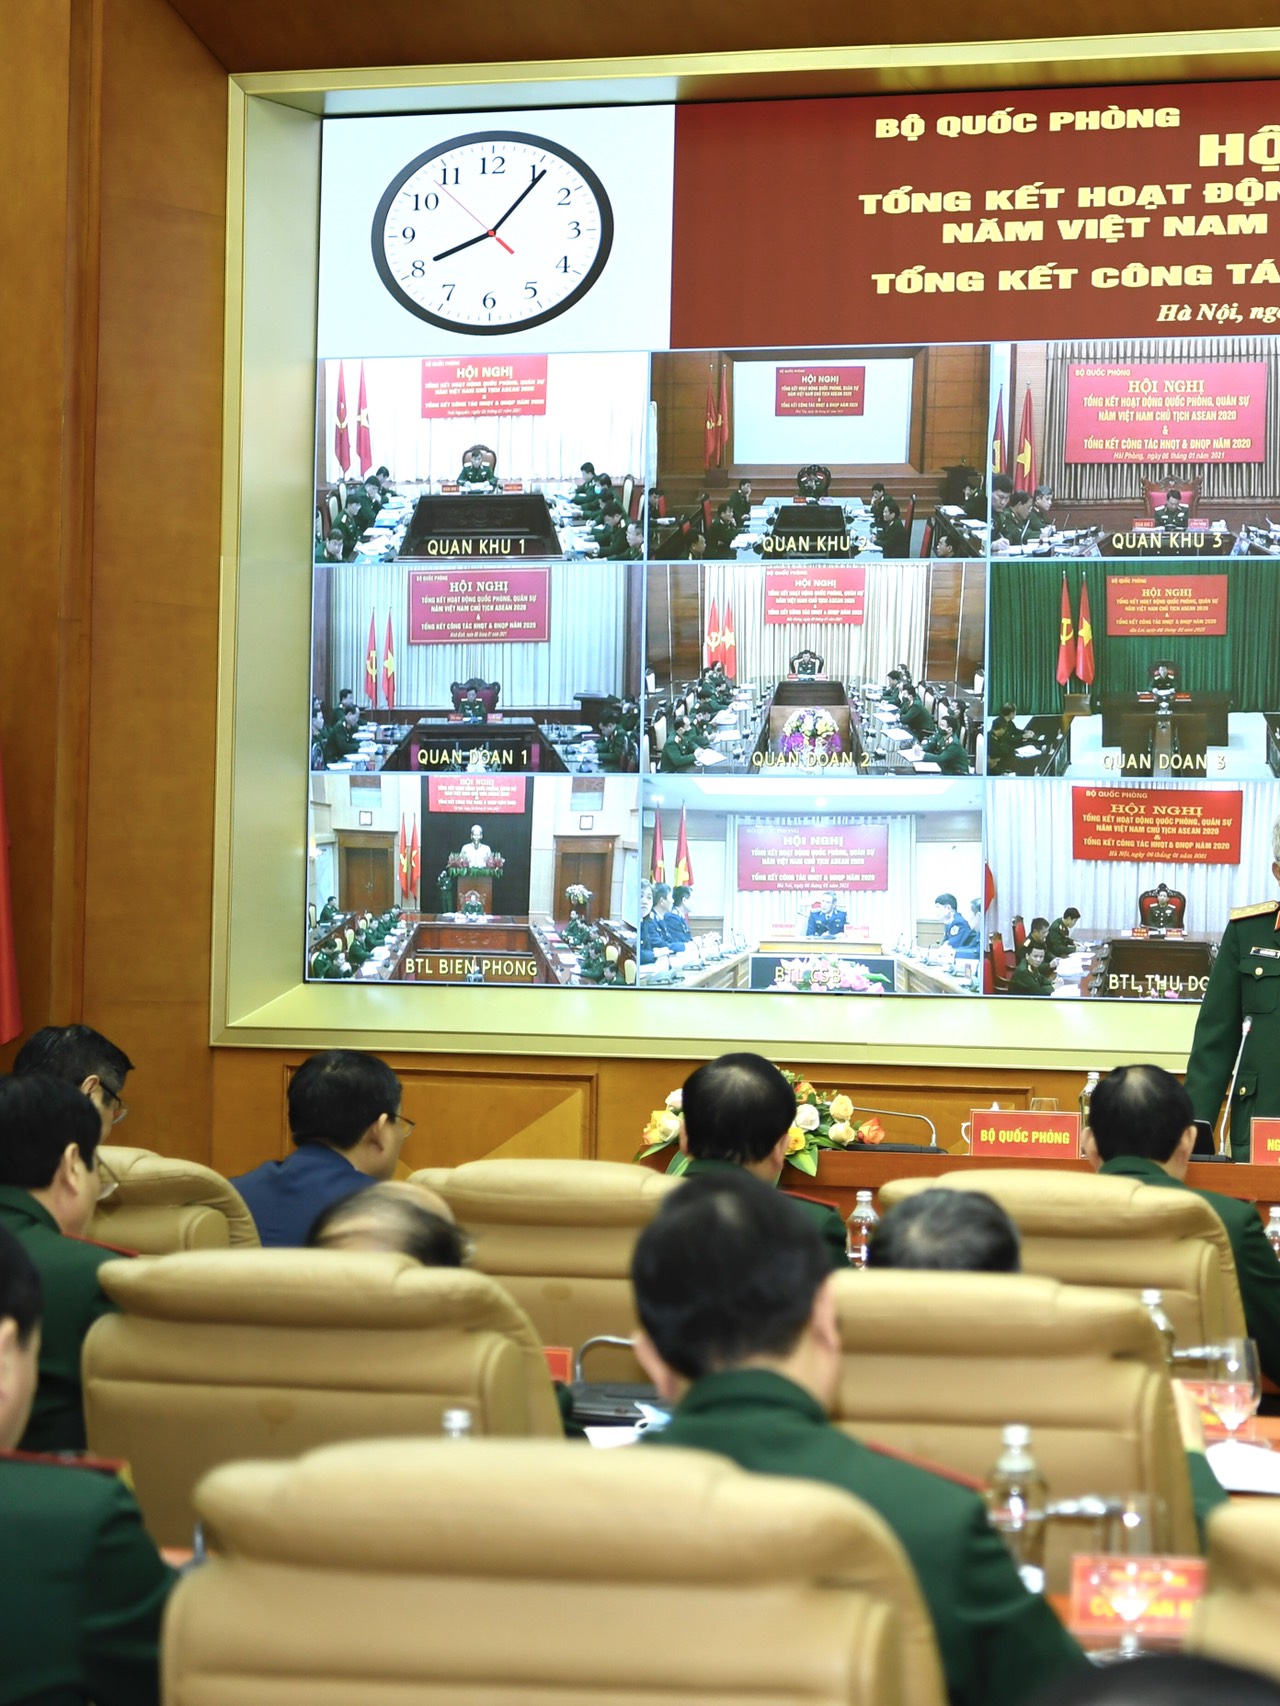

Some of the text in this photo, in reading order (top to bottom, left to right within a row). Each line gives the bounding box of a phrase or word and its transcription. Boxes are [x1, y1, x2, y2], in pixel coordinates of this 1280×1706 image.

[876, 105, 1180, 141] BỘ QUỐC PHÒNG
[480, 156, 506, 175] 12
[440, 168, 462, 186] 11
[413, 193, 440, 211] 10
[556, 187, 572, 206] 2
[859, 186, 971, 214] TỔNG
[986, 182, 1065, 210] KẾT
[1078, 184, 1192, 210] HOẠT
[401, 227, 417, 243] 9
[567, 221, 582, 239] 3
[943, 218, 1043, 243] NĂM
[1057, 214, 1150, 243] VIỆT
[1164, 214, 1268, 237] NAM
[410, 261, 426, 277] 8
[556, 256, 571, 273] 4
[871, 265, 984, 294] TỔNG
[999, 262, 1078, 291] KẾT
[1091, 263, 1212, 288] CÔNG
[441, 284, 457, 302] 7
[523, 281, 539, 298] 5
[481, 293, 498, 308] 6
[1156, 304, 1192, 321] Hà
[1196, 303, 1243, 324] Nội,
[457, 365, 513, 380] HỘI NGHỊ
[801, 374, 815, 386] HỘI
[1128, 378, 1204, 395] HỘI NGHỊ
[1136, 411, 1154, 421] NAM
[1191, 411, 1216, 420] ASEAN
[1218, 410, 1237, 420] 2020
[428, 539, 525, 556] QUAN KHU 1
[763, 536, 868, 552] QUAN KHU 2
[1112, 533, 1223, 549] QUAN KHU 3
[450, 580, 508, 594] HỘI NGHỊ
[1142, 587, 1192, 598] HỘI NGHỊ
[418, 749, 528, 765] QUAN DOAN 1
[752, 751, 871, 767] QUAN DOAN 2
[1103, 754, 1226, 770] QUAN DOAN 3
[1111, 802, 1203, 817] HỘI NGHỊ
[405, 958, 538, 976] BTL BIEN PHONG
[1109, 974, 1139, 991] BTL
[1147, 975, 1180, 991] THU
[981, 1127, 1070, 1144] BỘ QUỐC PHÒNG
